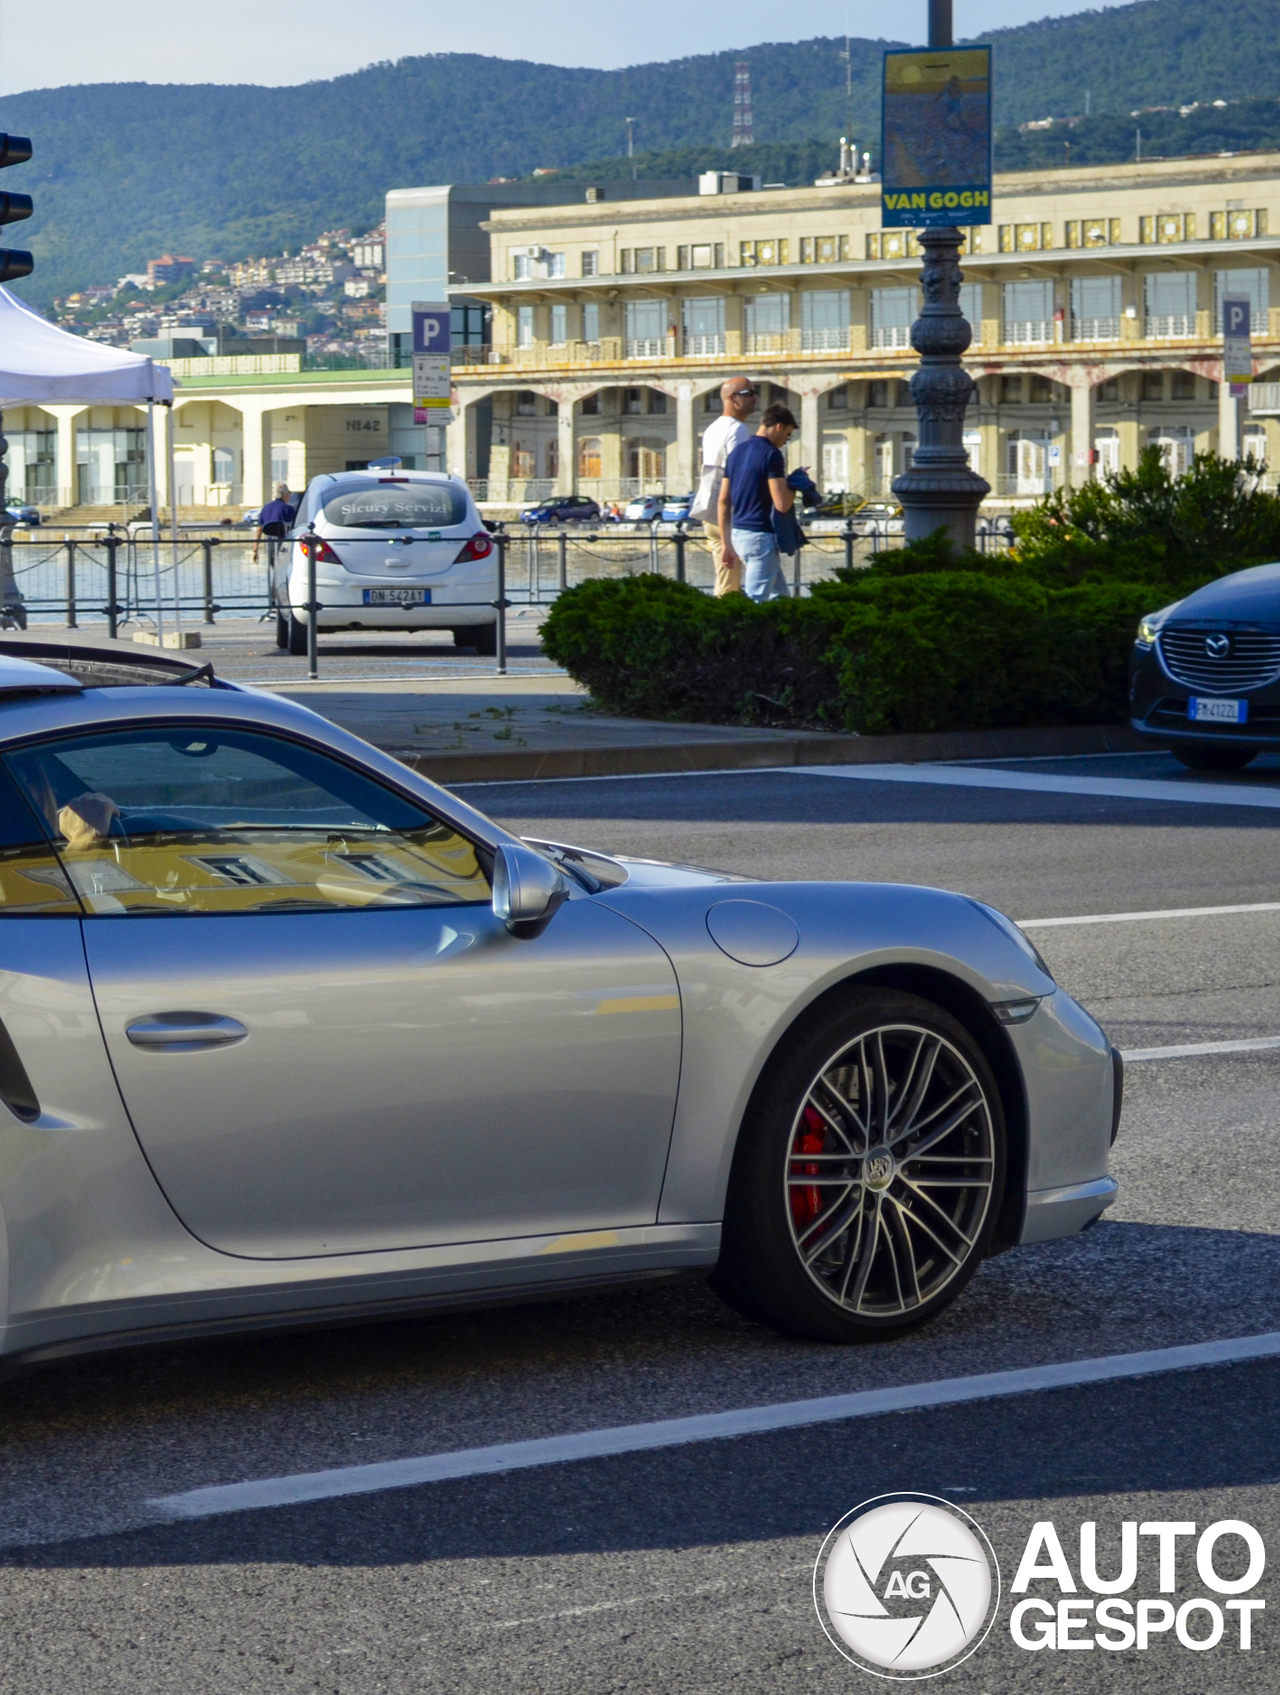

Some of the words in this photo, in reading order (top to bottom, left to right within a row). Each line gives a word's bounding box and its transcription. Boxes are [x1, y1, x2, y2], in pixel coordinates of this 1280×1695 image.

[883, 193, 926, 210] VAN
[929, 191, 989, 208] GOGH
[1230, 306, 1243, 331] P
[423, 318, 441, 347] P
[341, 503, 390, 514] Sicury
[394, 501, 448, 514] Servizi
